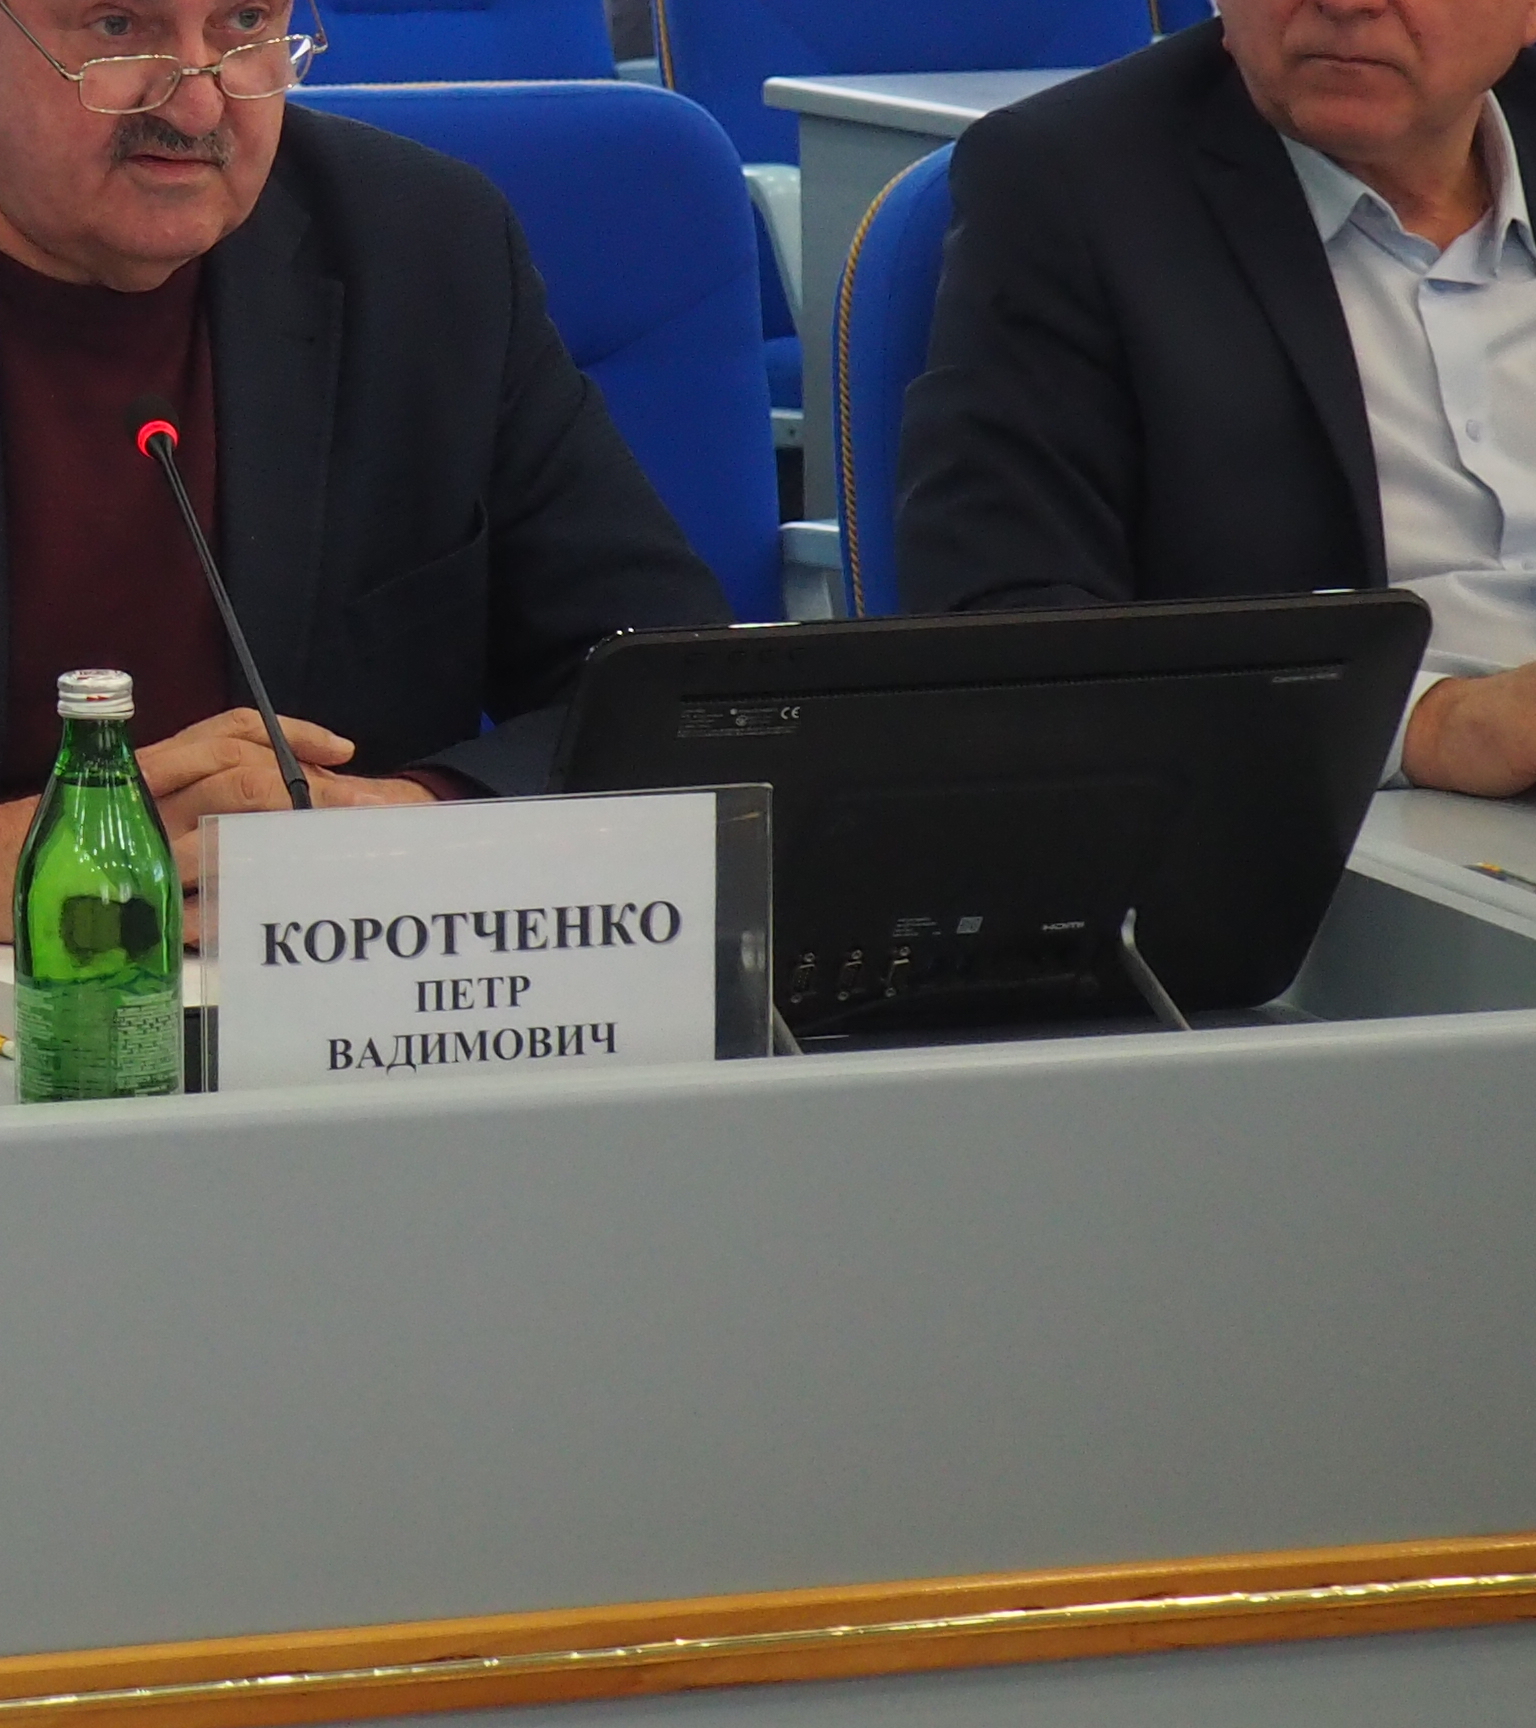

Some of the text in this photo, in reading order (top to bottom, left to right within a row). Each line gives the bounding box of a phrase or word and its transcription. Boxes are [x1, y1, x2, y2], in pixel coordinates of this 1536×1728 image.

[260, 900, 683, 967] КОРОТЧЕНКО
[415, 975, 531, 1013] ПЕТР
[327, 1021, 618, 1075] ВАДИМОВИЧ
